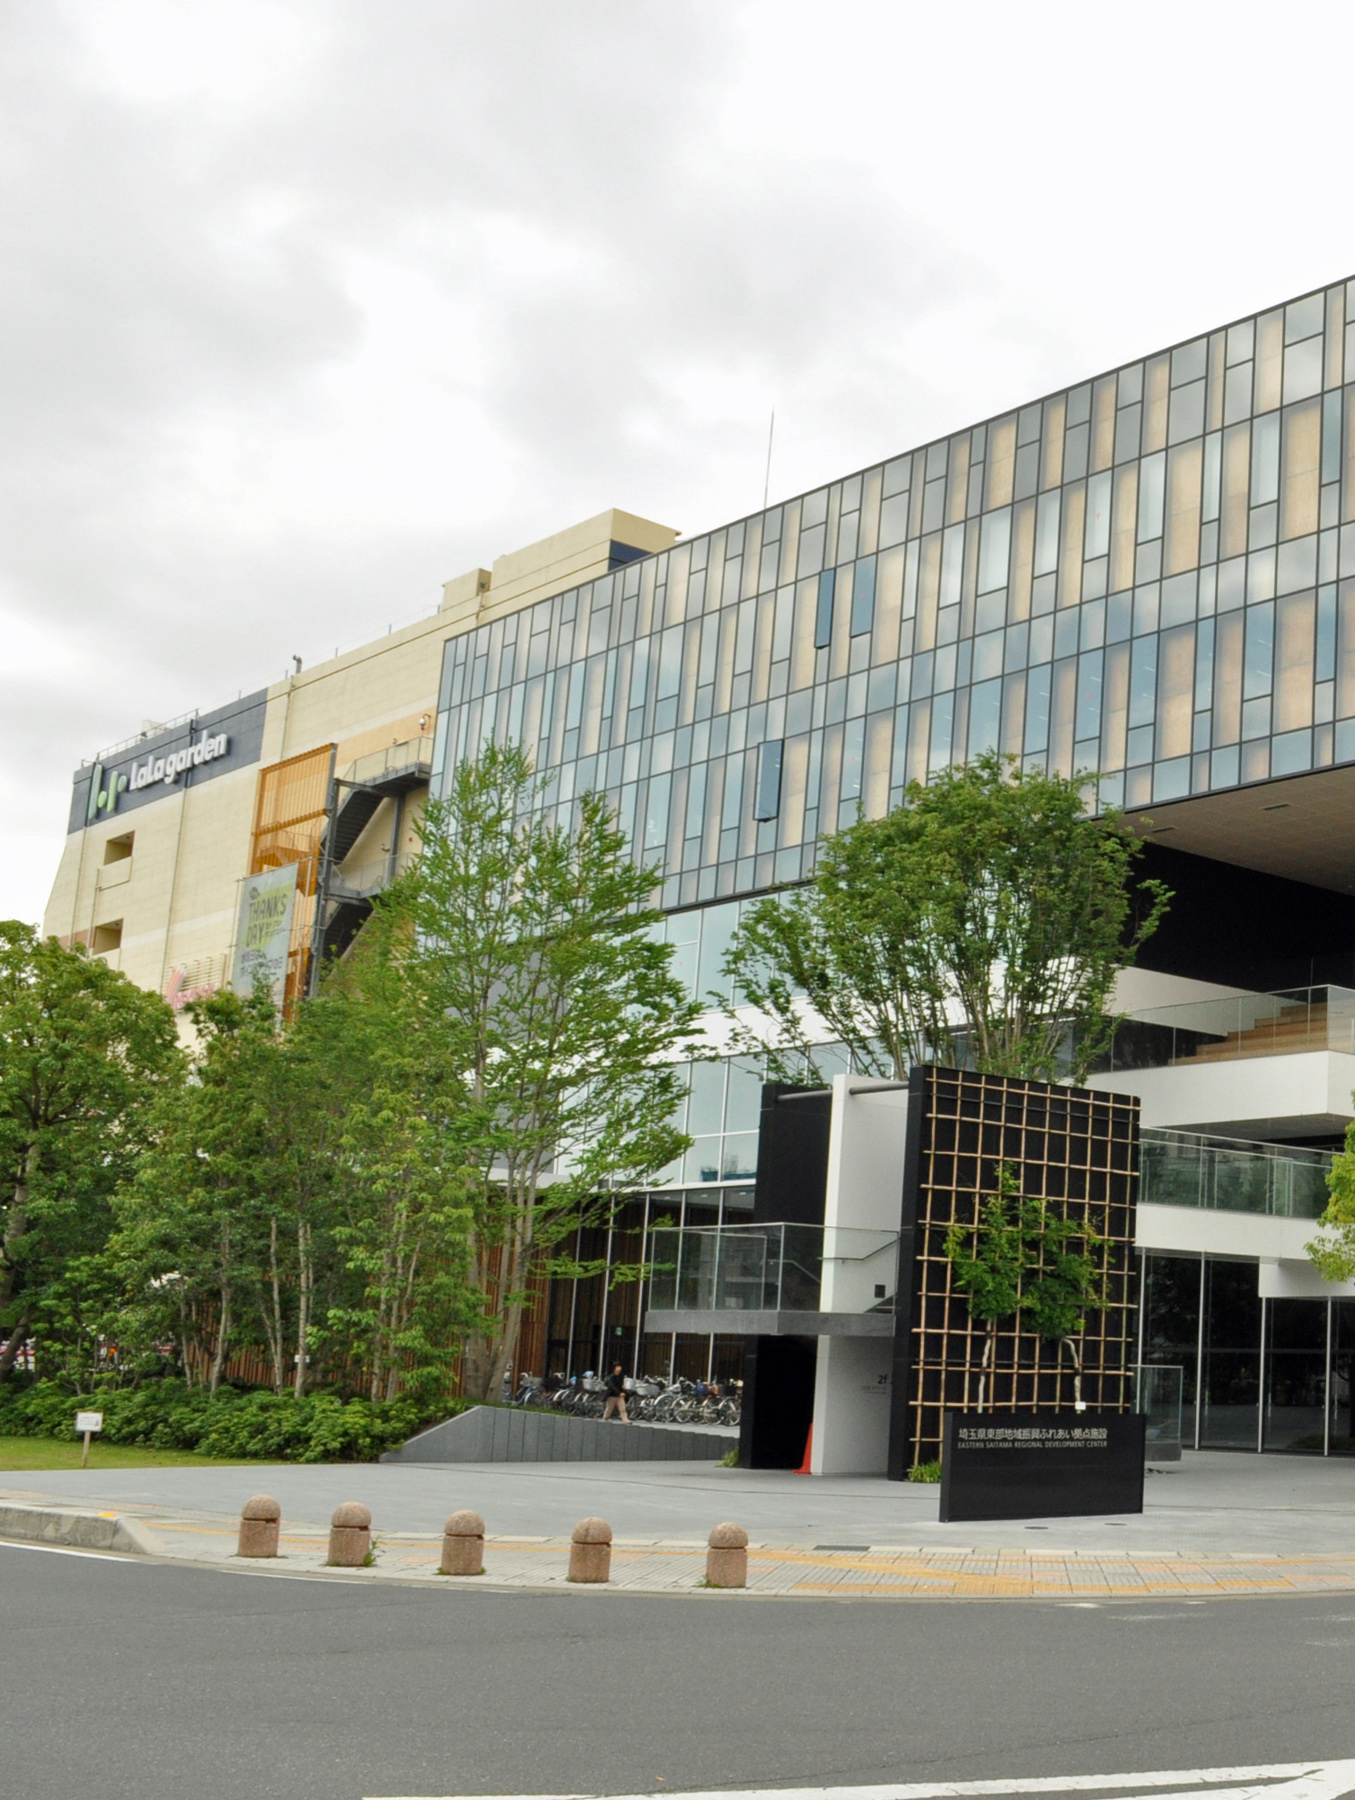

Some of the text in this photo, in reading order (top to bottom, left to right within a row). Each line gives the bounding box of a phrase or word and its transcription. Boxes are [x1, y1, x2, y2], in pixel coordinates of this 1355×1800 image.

[249, 893, 288, 922] THANKS
[246, 921, 266, 948] DAY
[957, 1440, 1108, 1449] EASTERN SAITAMA REGIONAL DEVELOPMENT CENTER
